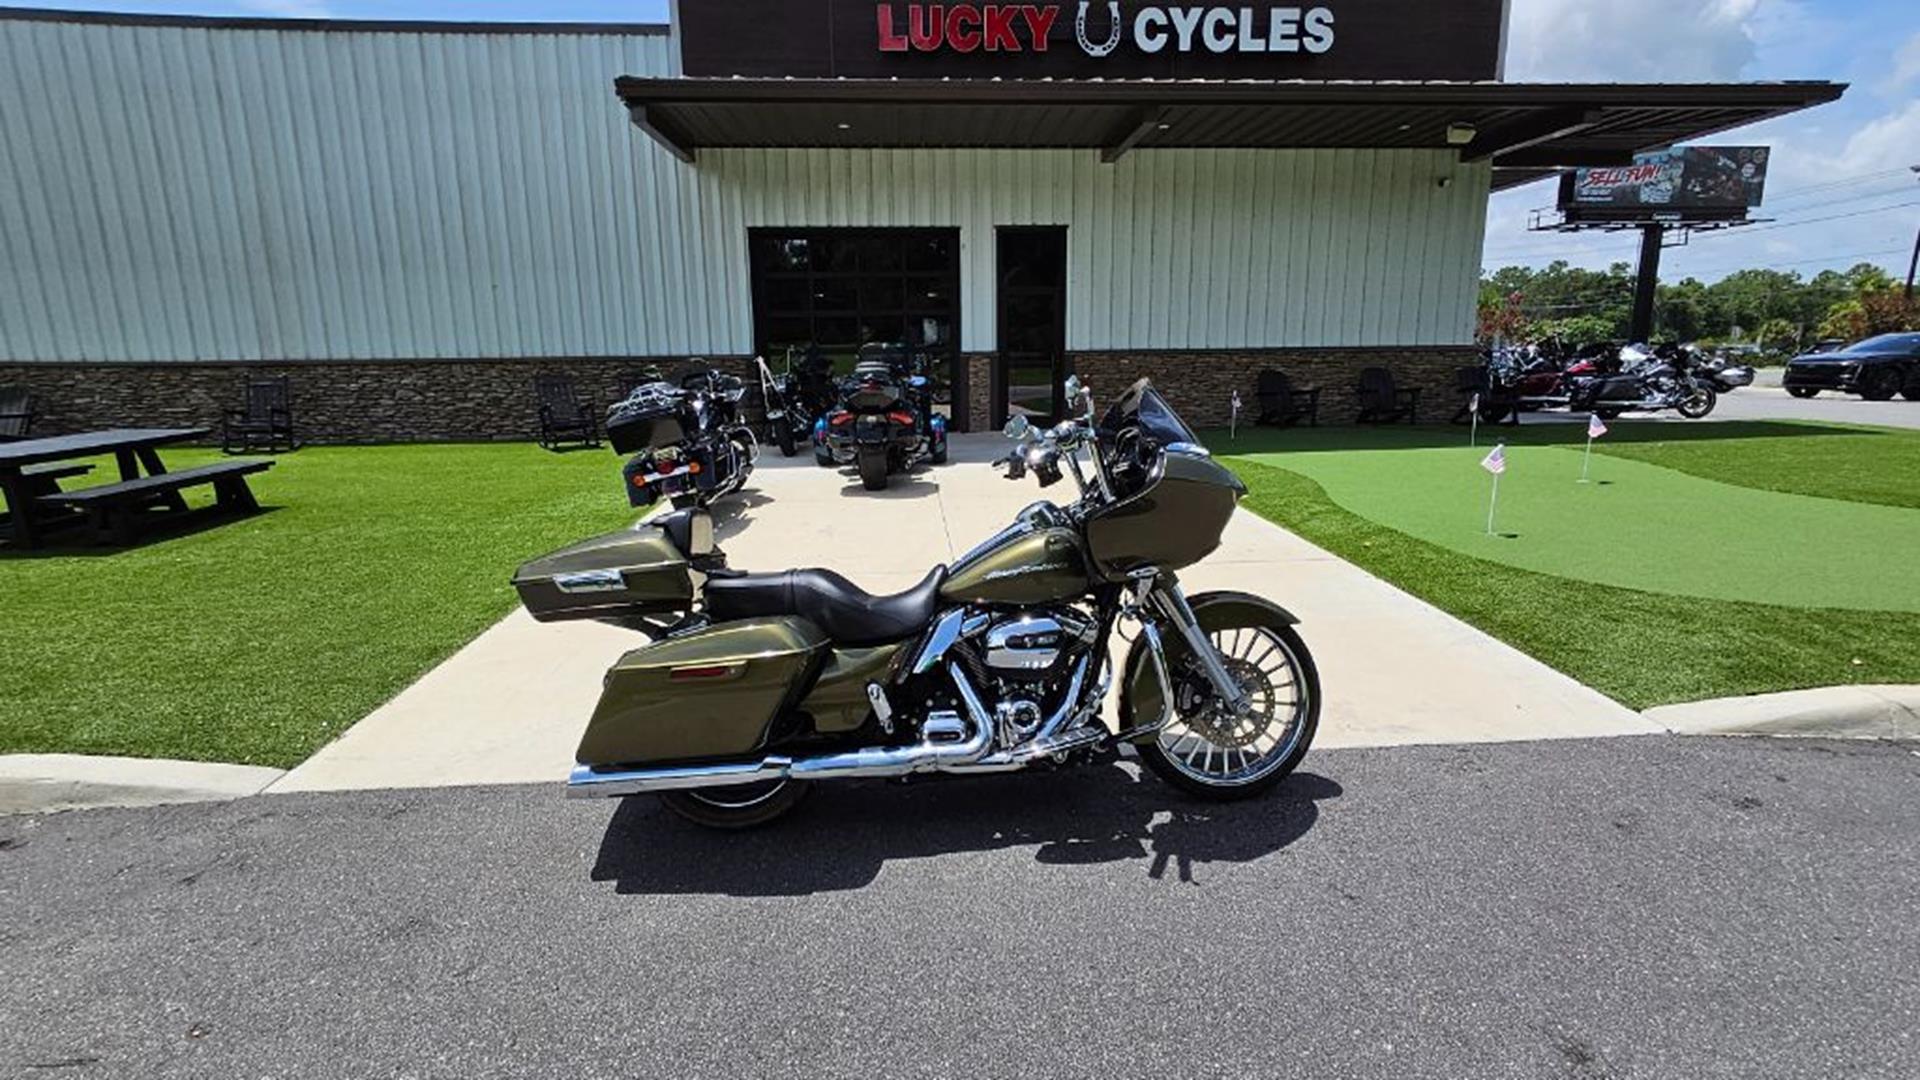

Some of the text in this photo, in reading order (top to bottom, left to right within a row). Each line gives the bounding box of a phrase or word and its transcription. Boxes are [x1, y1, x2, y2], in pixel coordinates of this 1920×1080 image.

[877, 3, 1335, 54] LUCKY CYCLES
[1582, 169, 1622, 188] SELL
